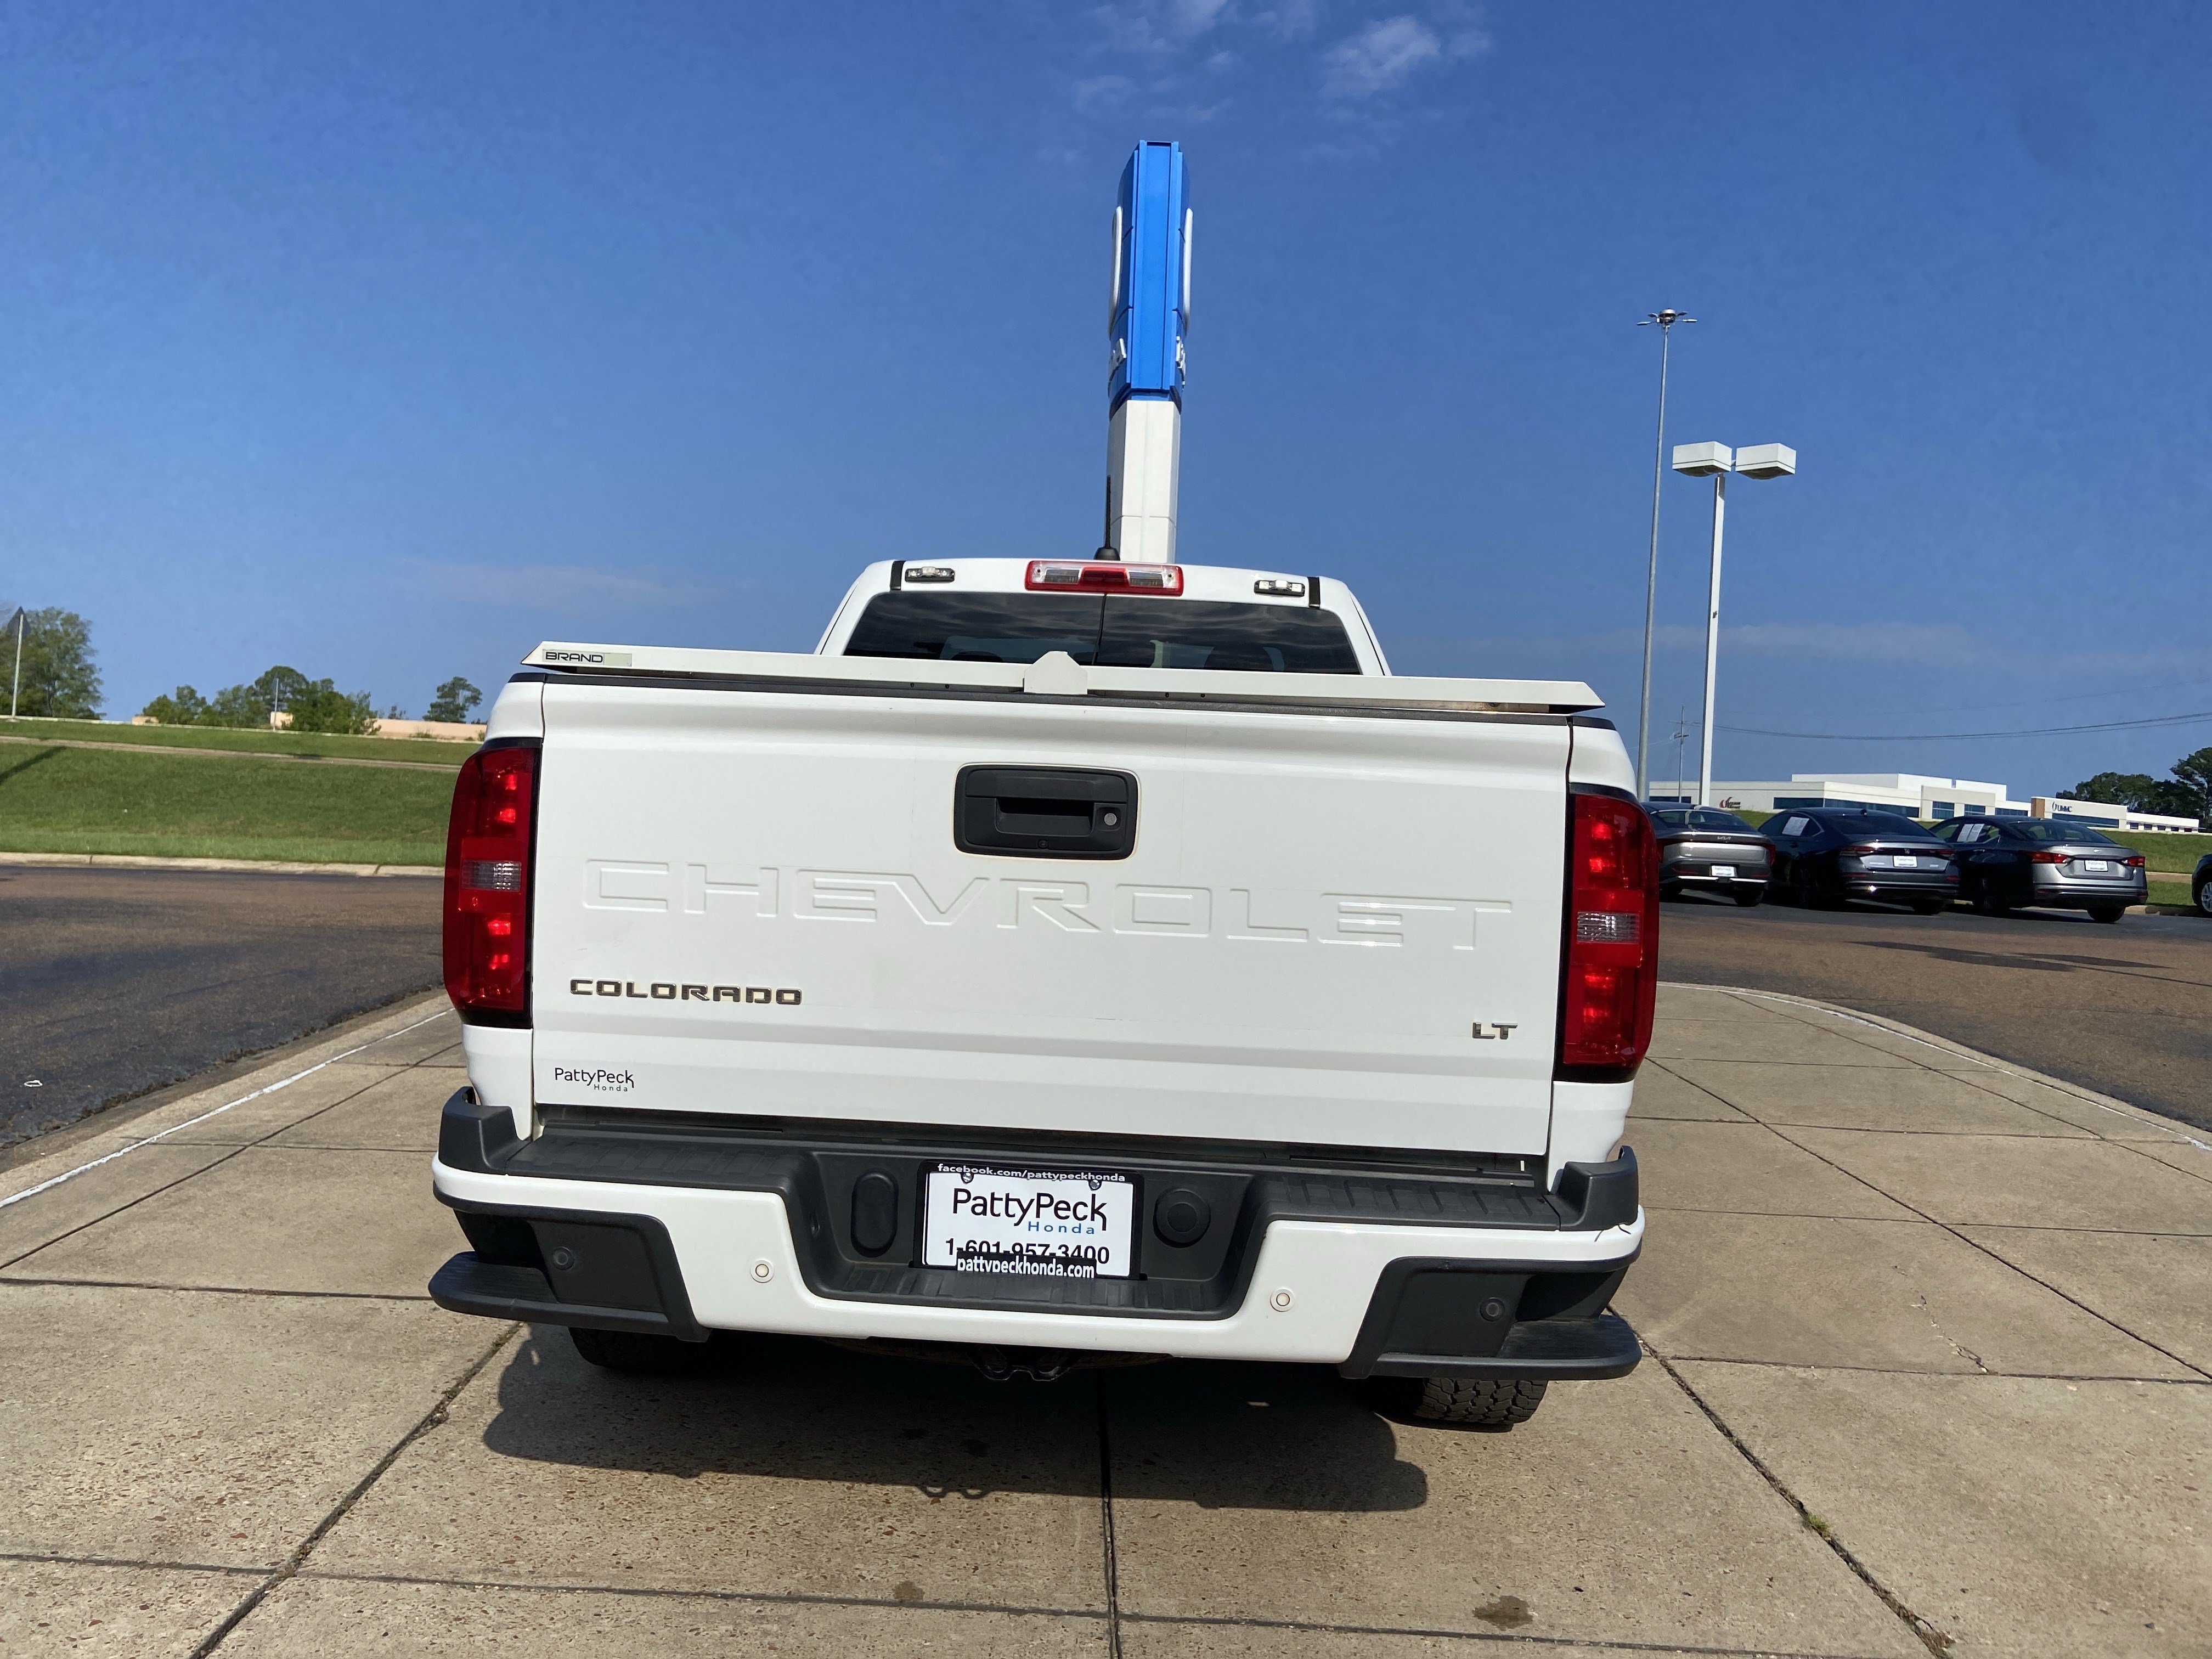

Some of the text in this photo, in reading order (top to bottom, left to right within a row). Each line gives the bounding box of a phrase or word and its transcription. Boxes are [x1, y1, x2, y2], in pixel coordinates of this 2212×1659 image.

[545, 651, 603, 663] BRAND
[583, 858, 1513, 951] CHEVROLET
[569, 977, 803, 1006] COLORADO
[1472, 1022, 1518, 1040] LT
[938, 1163, 1125, 1182] facebook.com/pattypeckhonda
[1028, 1221, 1095, 1234] Honda
